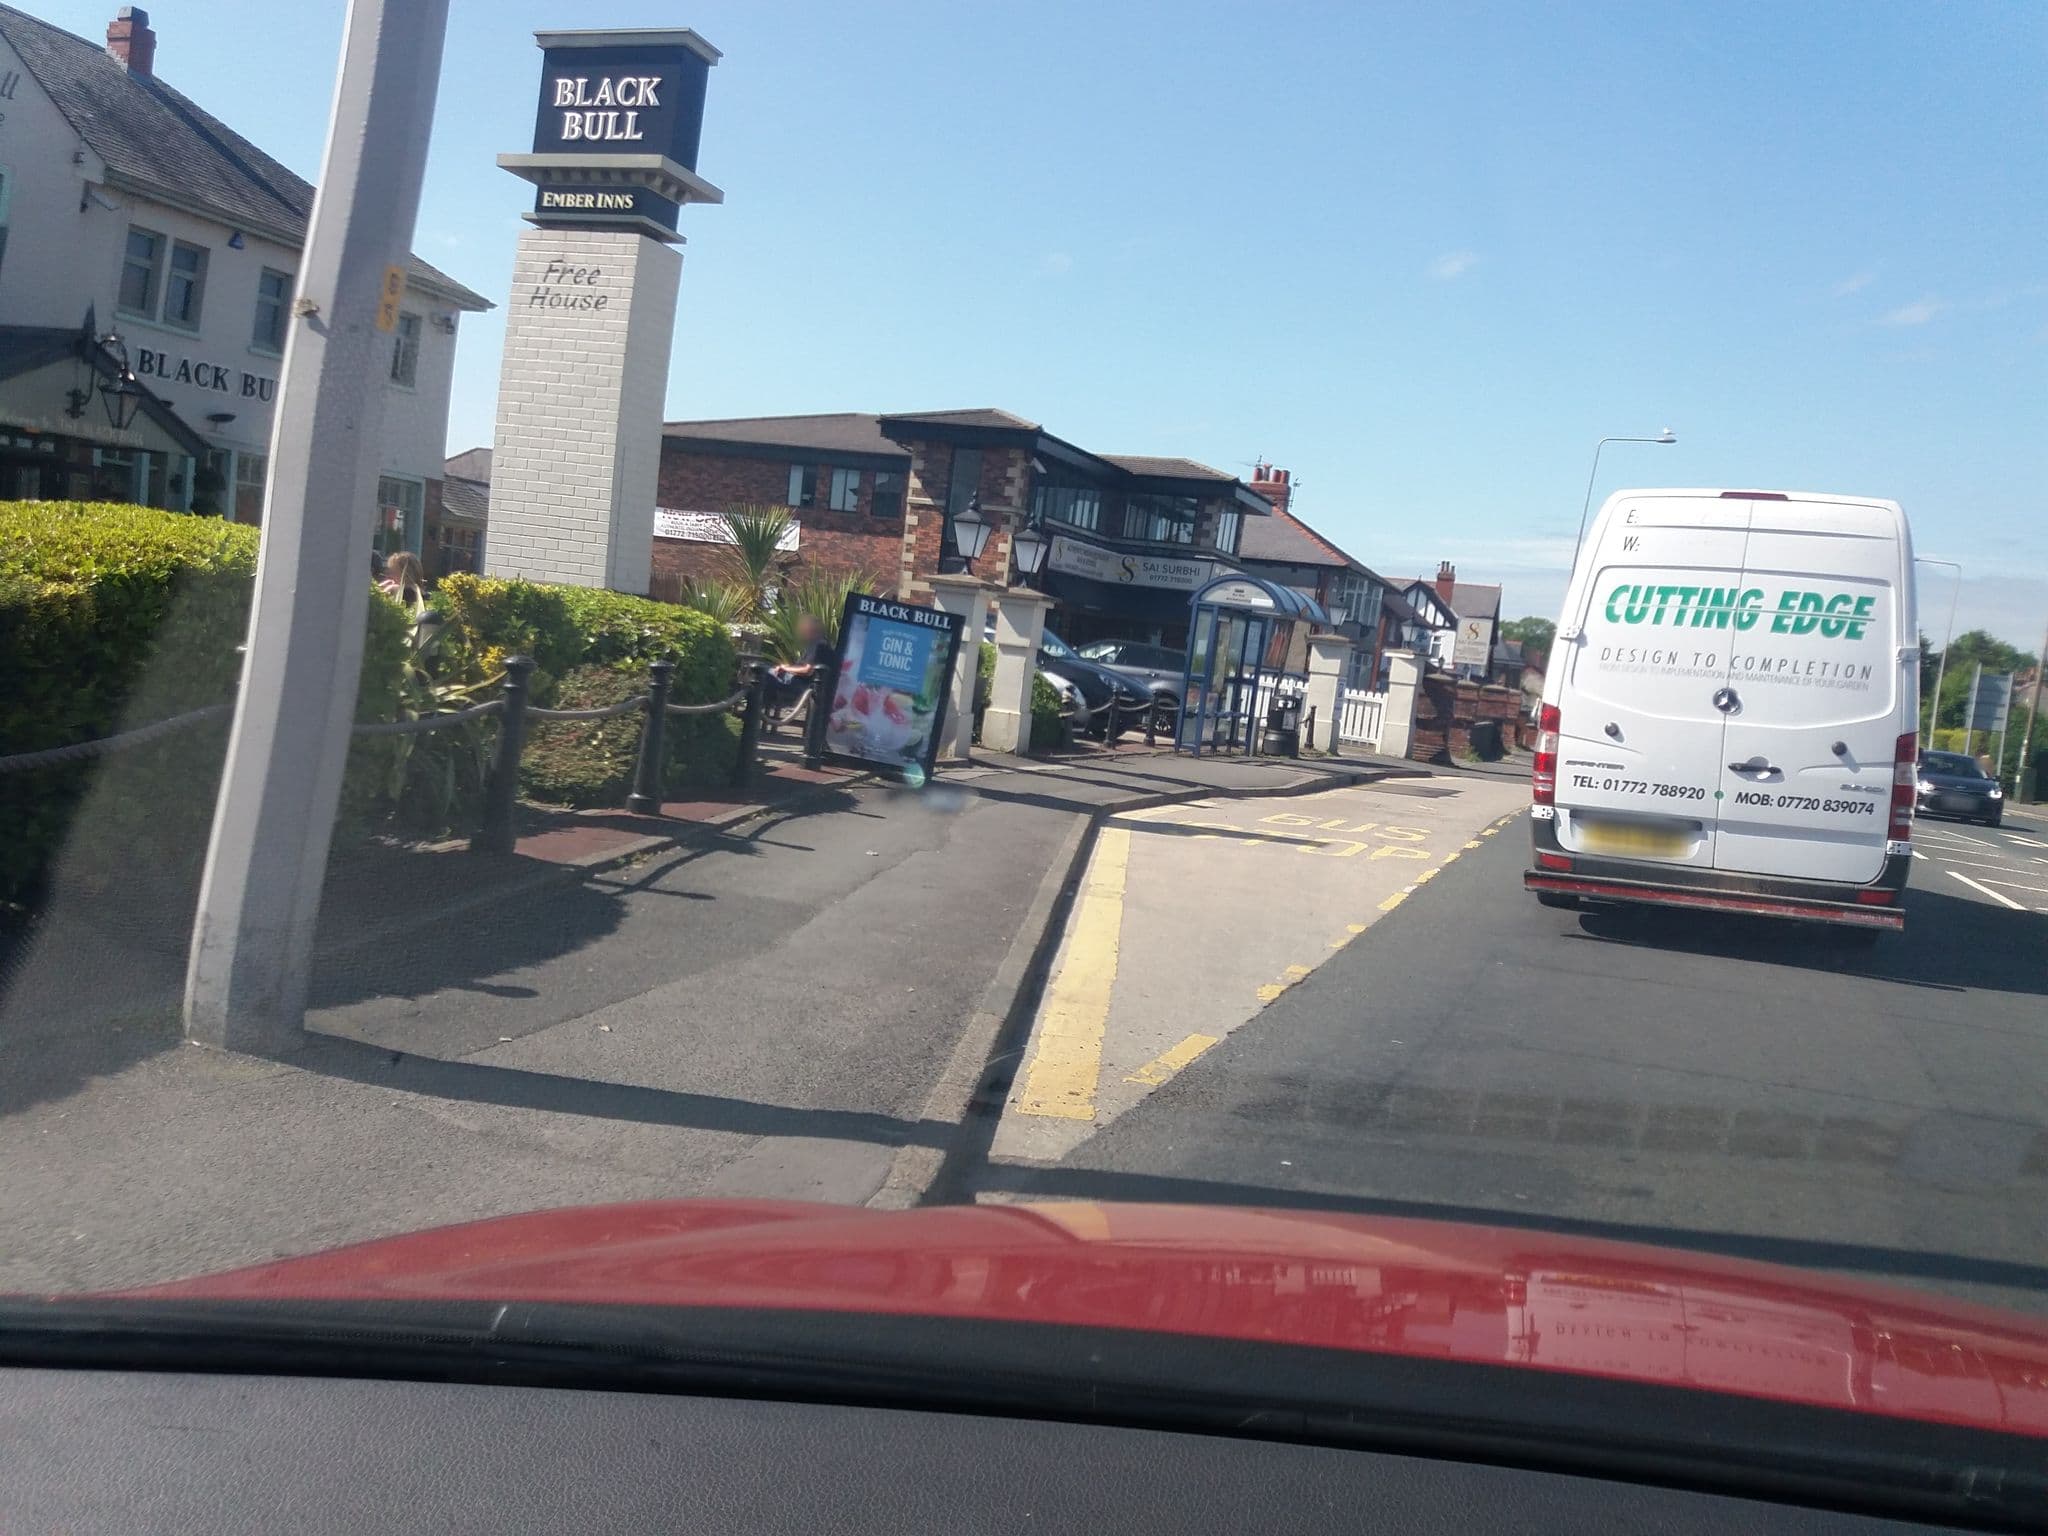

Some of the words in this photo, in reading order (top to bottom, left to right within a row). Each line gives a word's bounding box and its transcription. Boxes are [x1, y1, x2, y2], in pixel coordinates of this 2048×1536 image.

[553, 77, 663, 107] BLACK
[561, 111, 644, 141] BULL
[542, 191, 595, 209] EMBER
[596, 193, 634, 209] INNS
[543, 259, 601, 285] Free
[529, 286, 608, 311] House
[137, 348, 231, 392] BLACK
[241, 372, 280, 402] BU
[1623, 536, 1640, 551] W:
[1143, 562, 1161, 573] SAI
[1162, 562, 1201, 577] SURBHI
[860, 599, 910, 621] BLACK
[913, 610, 952, 630] BULL
[1605, 584, 1765, 631] CUTTING
[1770, 591, 1876, 640] EDGE
[882, 636, 904, 654] GIN
[904, 641, 914, 657] &
[880, 651, 913, 672] TONIC
[1601, 647, 1679, 665] DESIGN
[1693, 652, 1716, 668] TO
[1731, 655, 1872, 681] COMPLETION
[1565, 759, 1626, 771] SPRINTER
[1573, 775, 1600, 789] TEL:
[1603, 779, 1648, 794] 01772
[1651, 783, 1706, 800] 788920
[1734, 791, 1774, 807] MOB:
[1777, 796, 1820, 811] 07720
[1822, 800, 1875, 815] 839074
